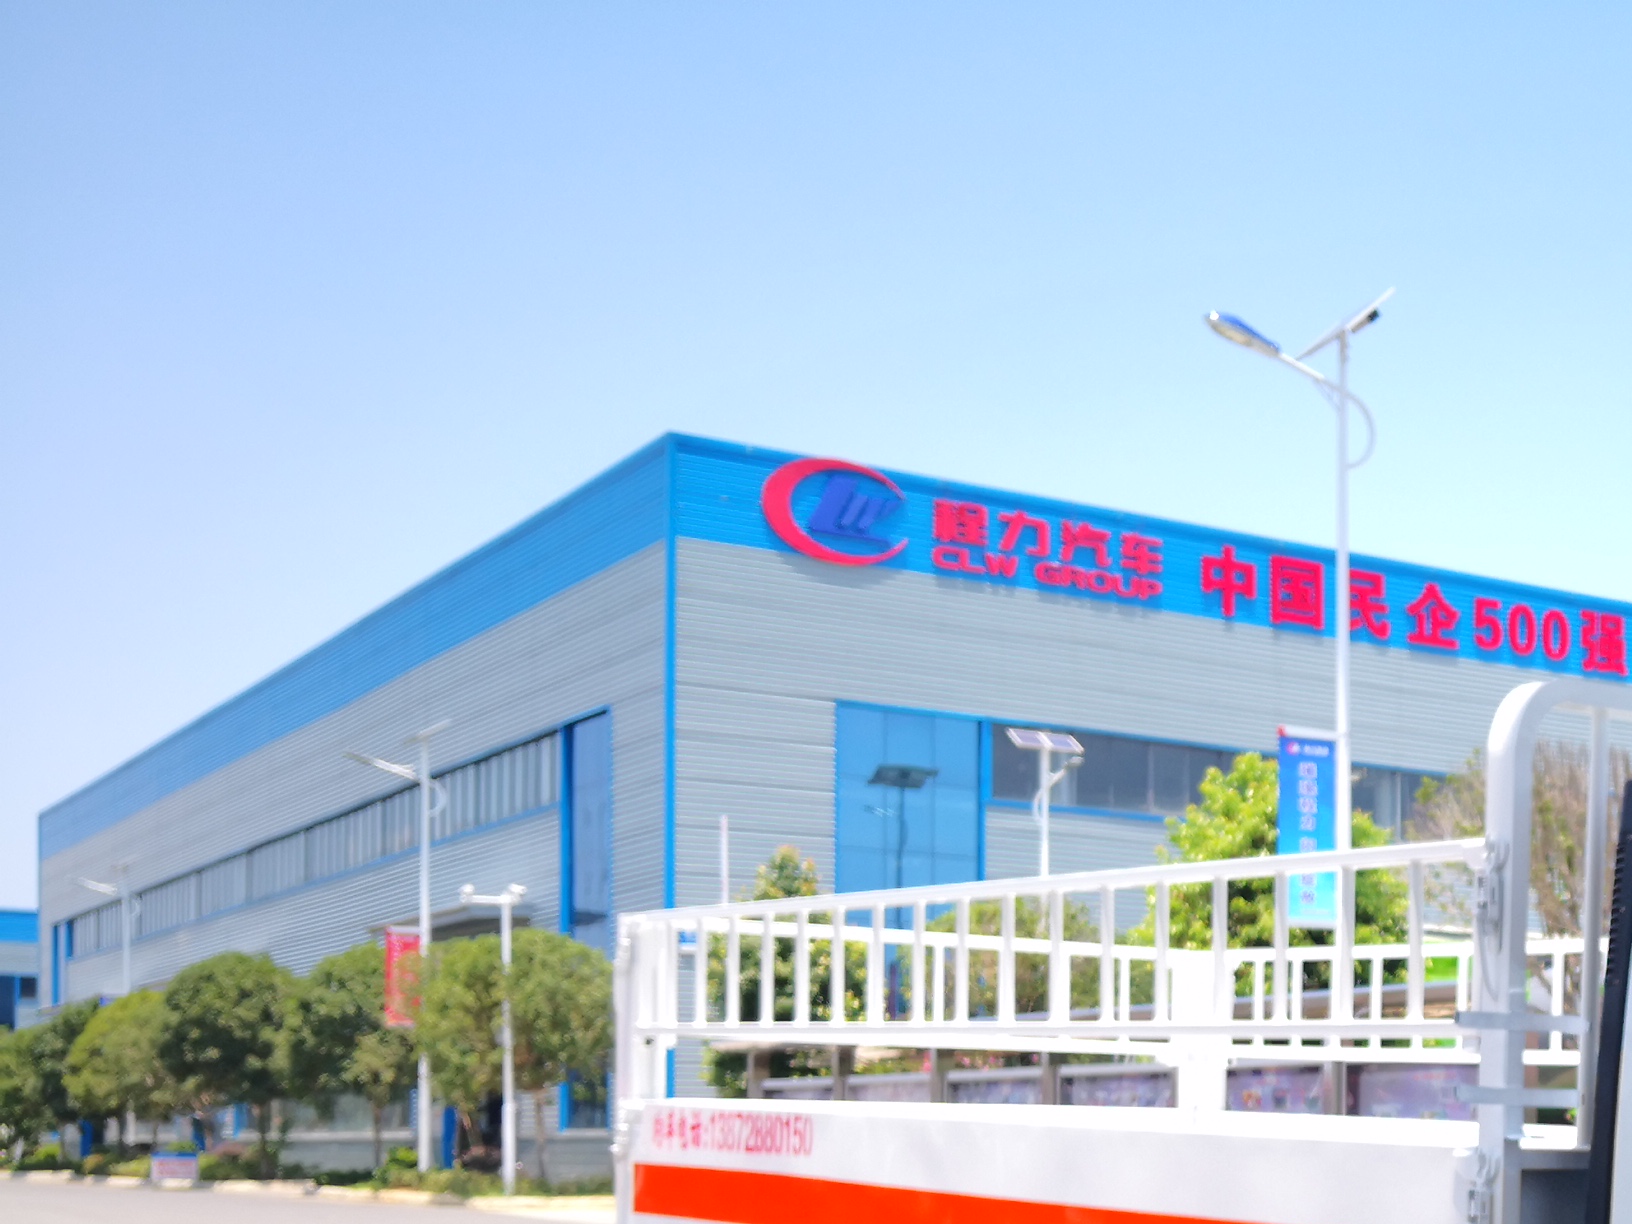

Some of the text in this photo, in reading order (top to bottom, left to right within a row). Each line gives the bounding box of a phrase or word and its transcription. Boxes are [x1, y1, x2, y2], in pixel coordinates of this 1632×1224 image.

[932, 499, 1163, 574] 程力汽车
[932, 545, 1163, 600] CLW GROUP
